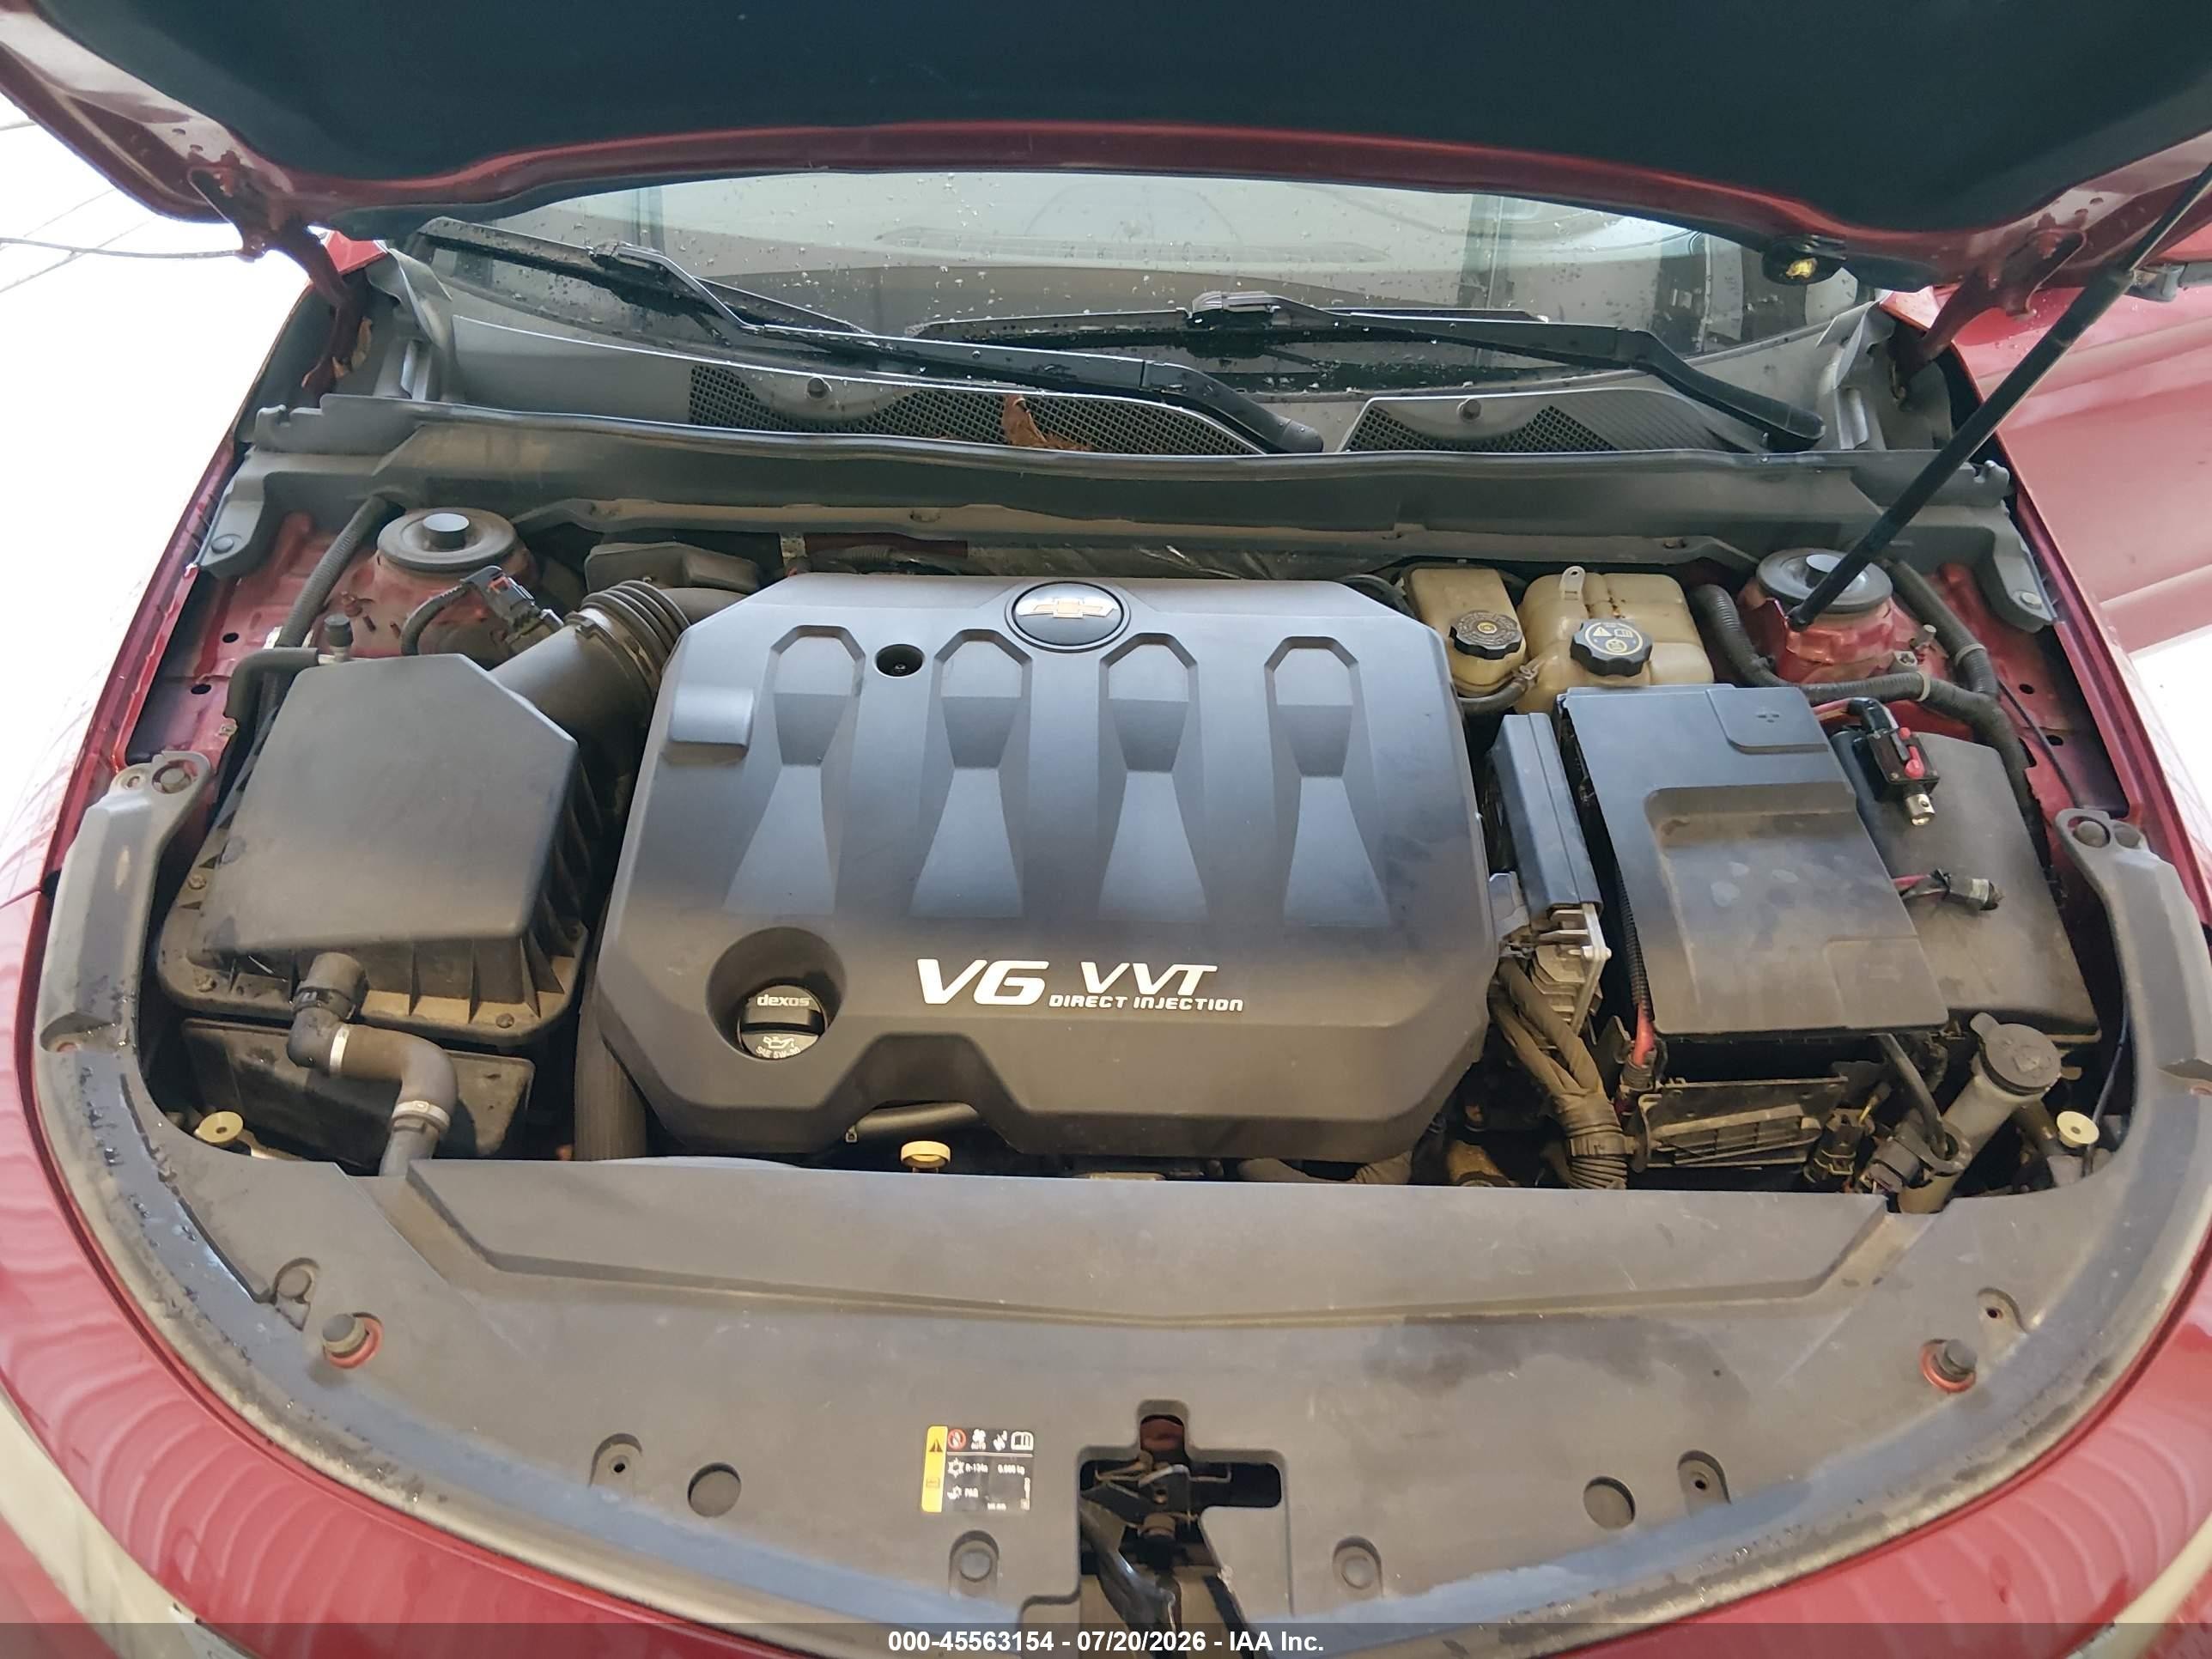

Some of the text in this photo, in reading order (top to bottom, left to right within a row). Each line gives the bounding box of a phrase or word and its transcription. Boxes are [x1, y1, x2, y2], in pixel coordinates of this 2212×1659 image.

[916, 958, 1218, 1006] V6 VVT
[757, 994, 811, 1006] dexos
[1048, 994, 1244, 1012] DIRECT INJECTION
[756, 1046, 771, 1058] SAE
